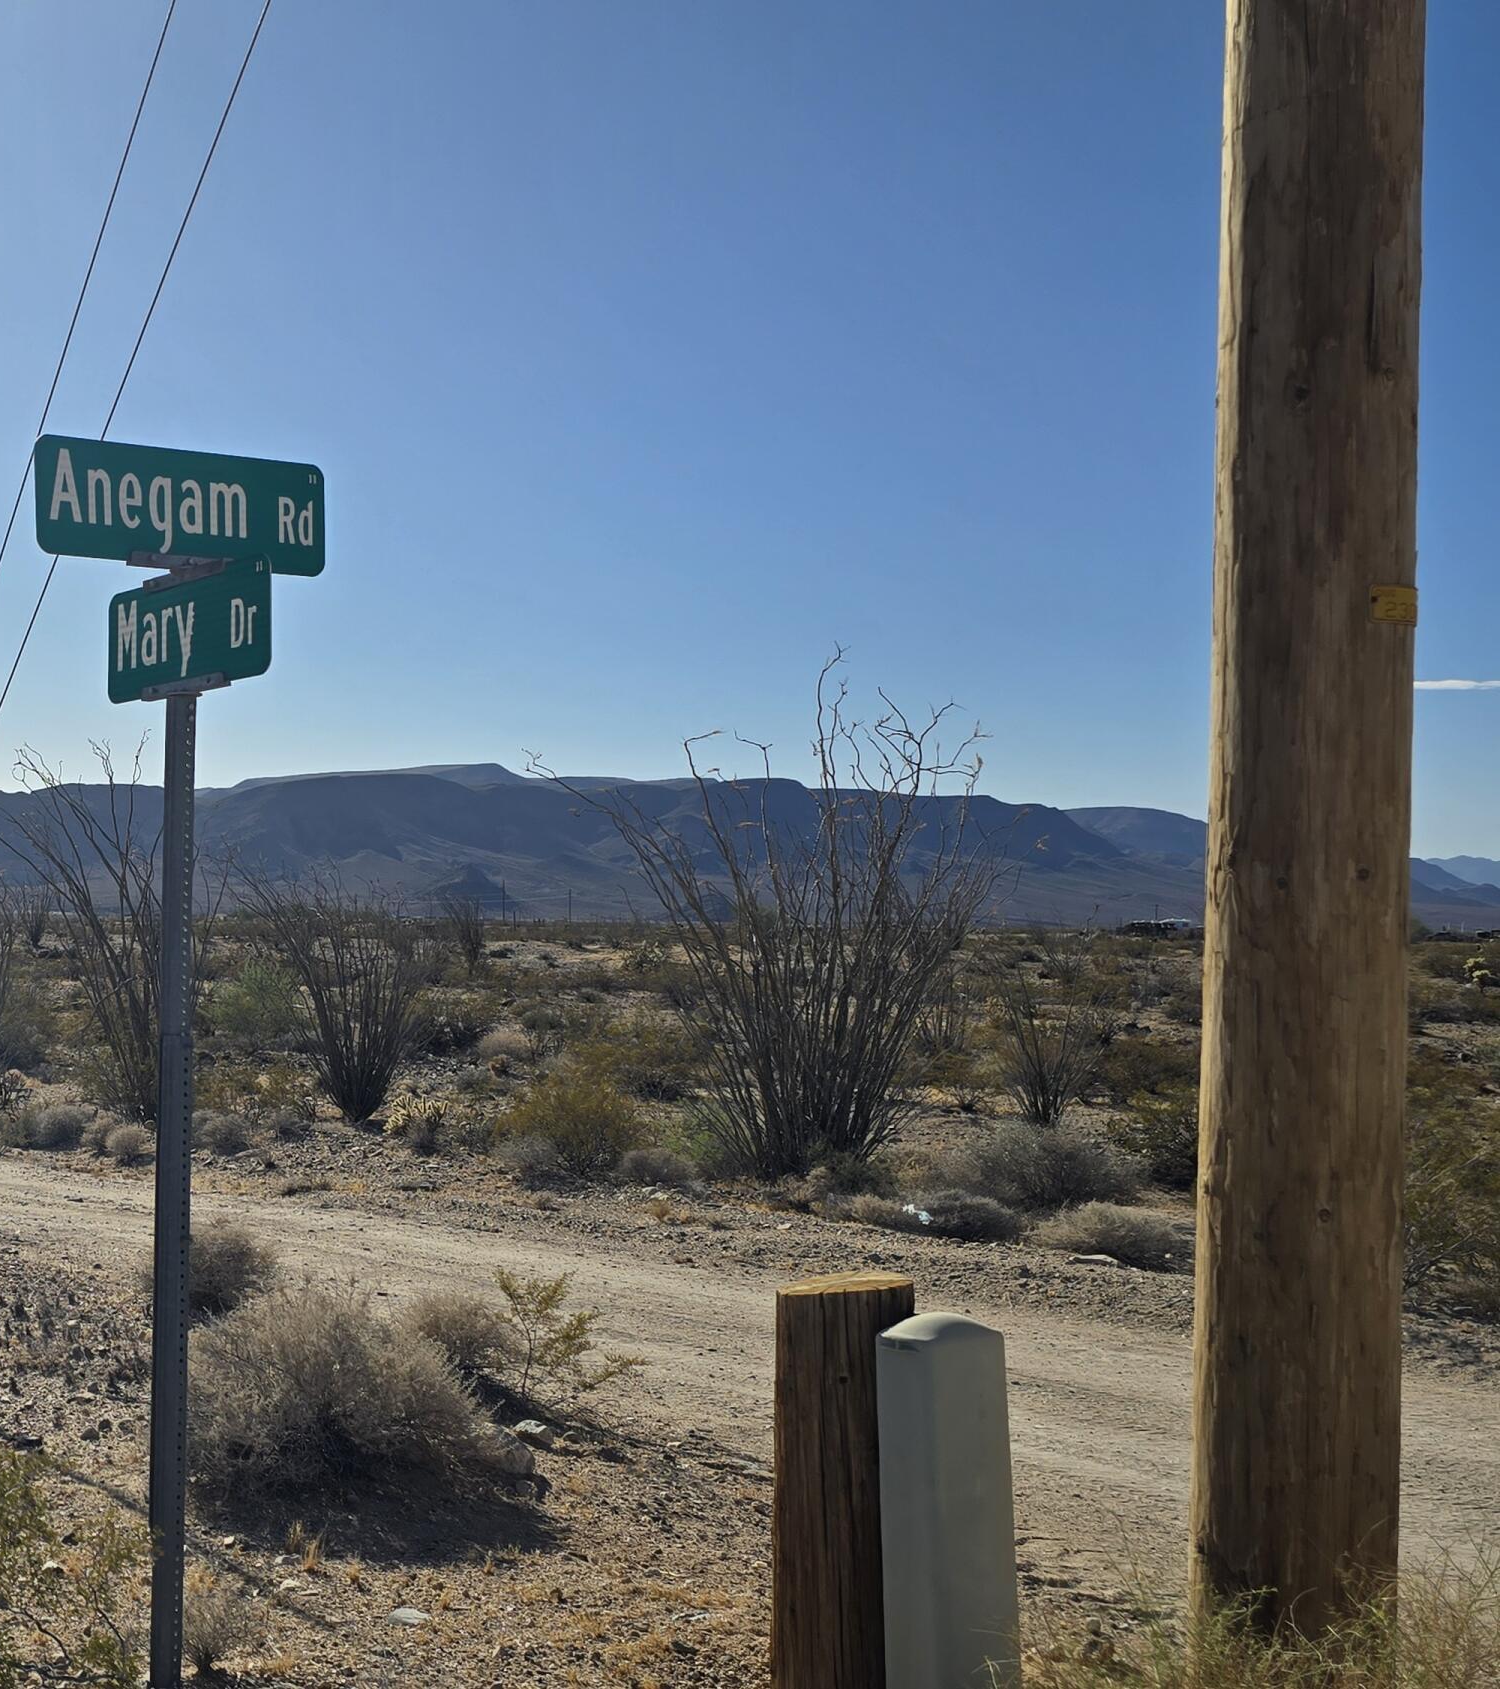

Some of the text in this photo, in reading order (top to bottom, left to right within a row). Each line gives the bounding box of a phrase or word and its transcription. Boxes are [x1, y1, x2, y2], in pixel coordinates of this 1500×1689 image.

[49, 447, 314, 554] Anegam Rd
[117, 597, 258, 678] Mary Dr
